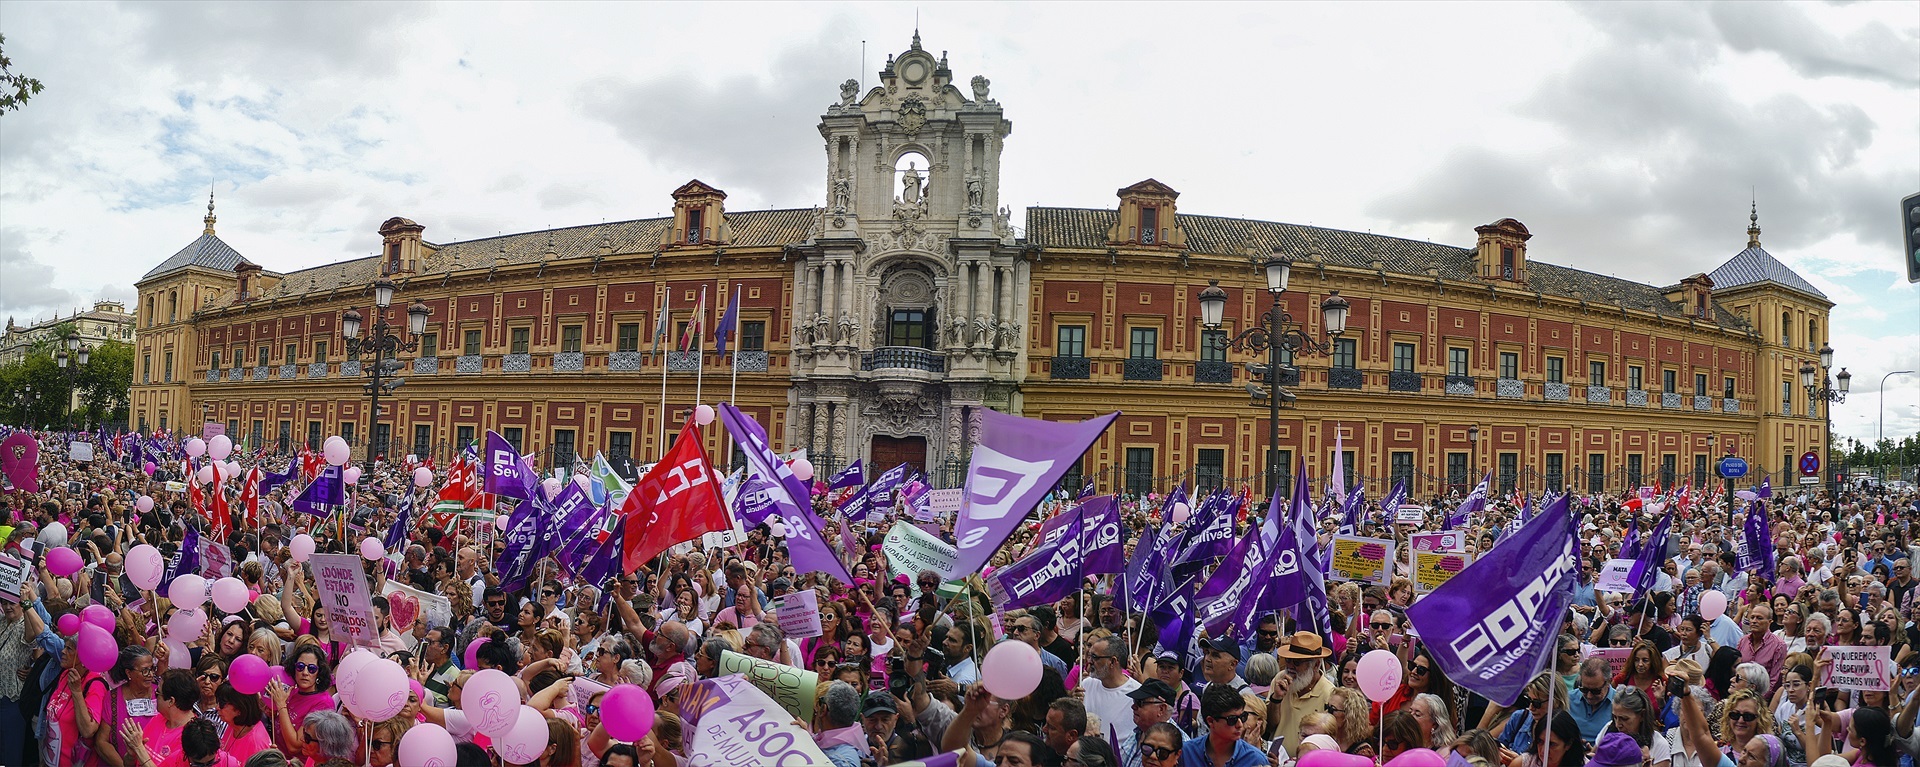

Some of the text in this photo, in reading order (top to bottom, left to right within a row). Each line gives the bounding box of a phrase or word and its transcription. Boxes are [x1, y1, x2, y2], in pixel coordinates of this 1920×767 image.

[928, 543, 939, 553] SAN
[938, 547, 959, 560] MARCO
[322, 566, 354, 581] ¿DÓNDE
[324, 579, 355, 594] ESTÁN?
[335, 593, 349, 607] NO
[1831, 651, 1877, 661] NO QUEREMOS
[1835, 663, 1873, 674] SOBREVIVIR,
[1830, 675, 1881, 687] QUEREMOS VIVIR
[707, 724, 728, 742] DE
[713, 736, 763, 767] MUJE
